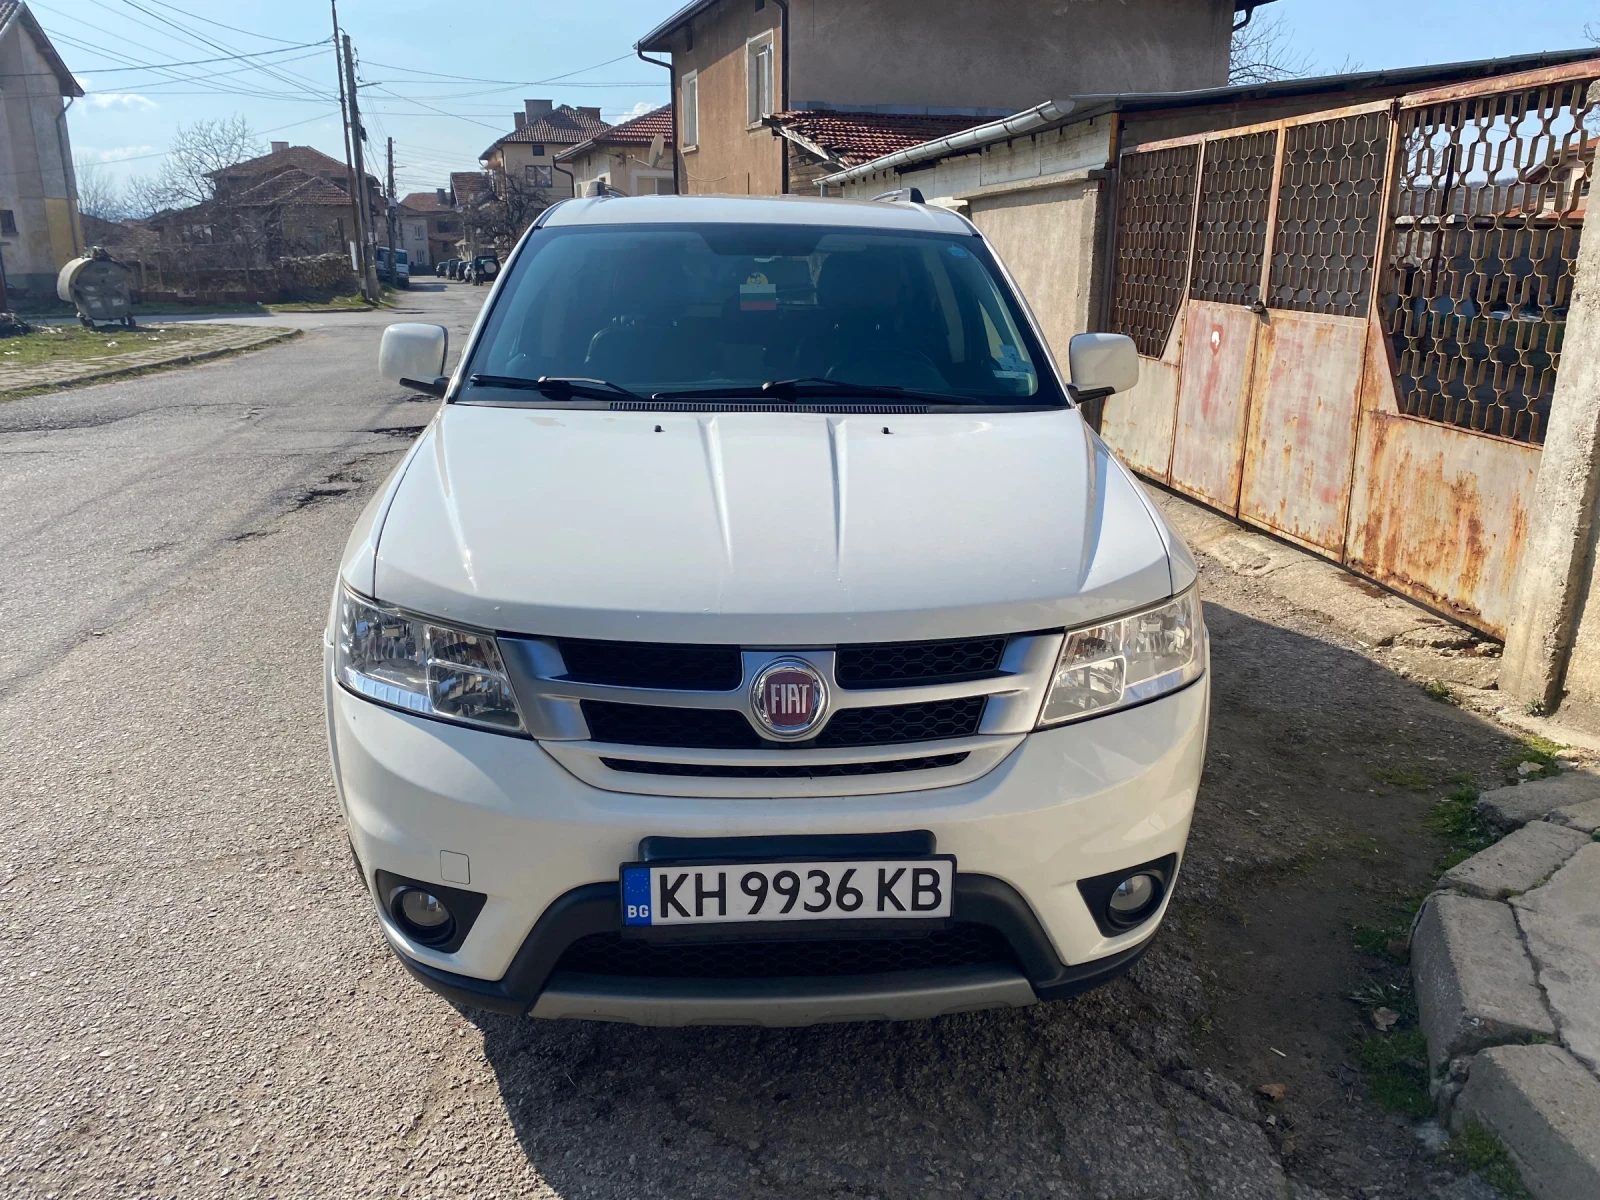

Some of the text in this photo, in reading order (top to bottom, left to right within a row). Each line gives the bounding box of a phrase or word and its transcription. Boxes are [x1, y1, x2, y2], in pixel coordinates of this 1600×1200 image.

[770, 683, 810, 714] FIAT
[659, 867, 943, 919] KH 9936 KB
[627, 904, 649, 919] BG
